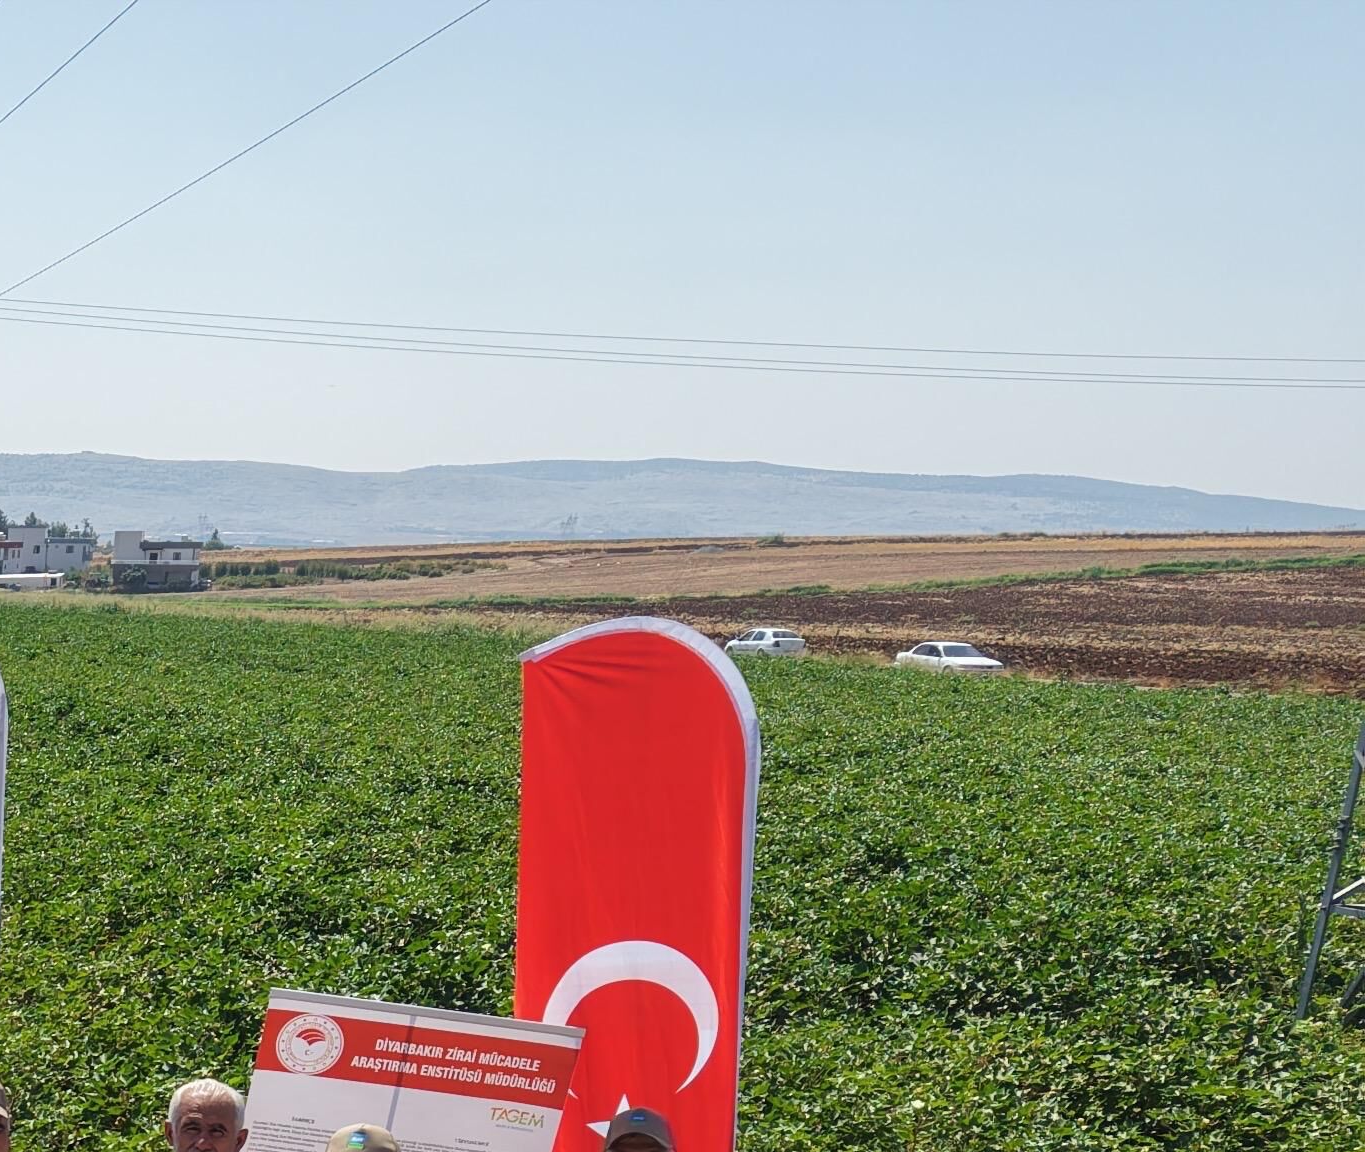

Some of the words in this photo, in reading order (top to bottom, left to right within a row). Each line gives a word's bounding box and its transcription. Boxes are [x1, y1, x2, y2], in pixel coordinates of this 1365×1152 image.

[375, 1036, 444, 1060] DİYARBAKIR
[445, 1046, 477, 1063] ZİRAİ
[479, 1052, 541, 1072] MÜCADELE
[350, 1054, 418, 1075] ARAŞTIRMA
[420, 1062, 483, 1083] ENSTİTÜSÜ
[484, 1072, 556, 1094] MÜDÜRLÜĞÜ
[490, 1106, 545, 1129] TAGEM
